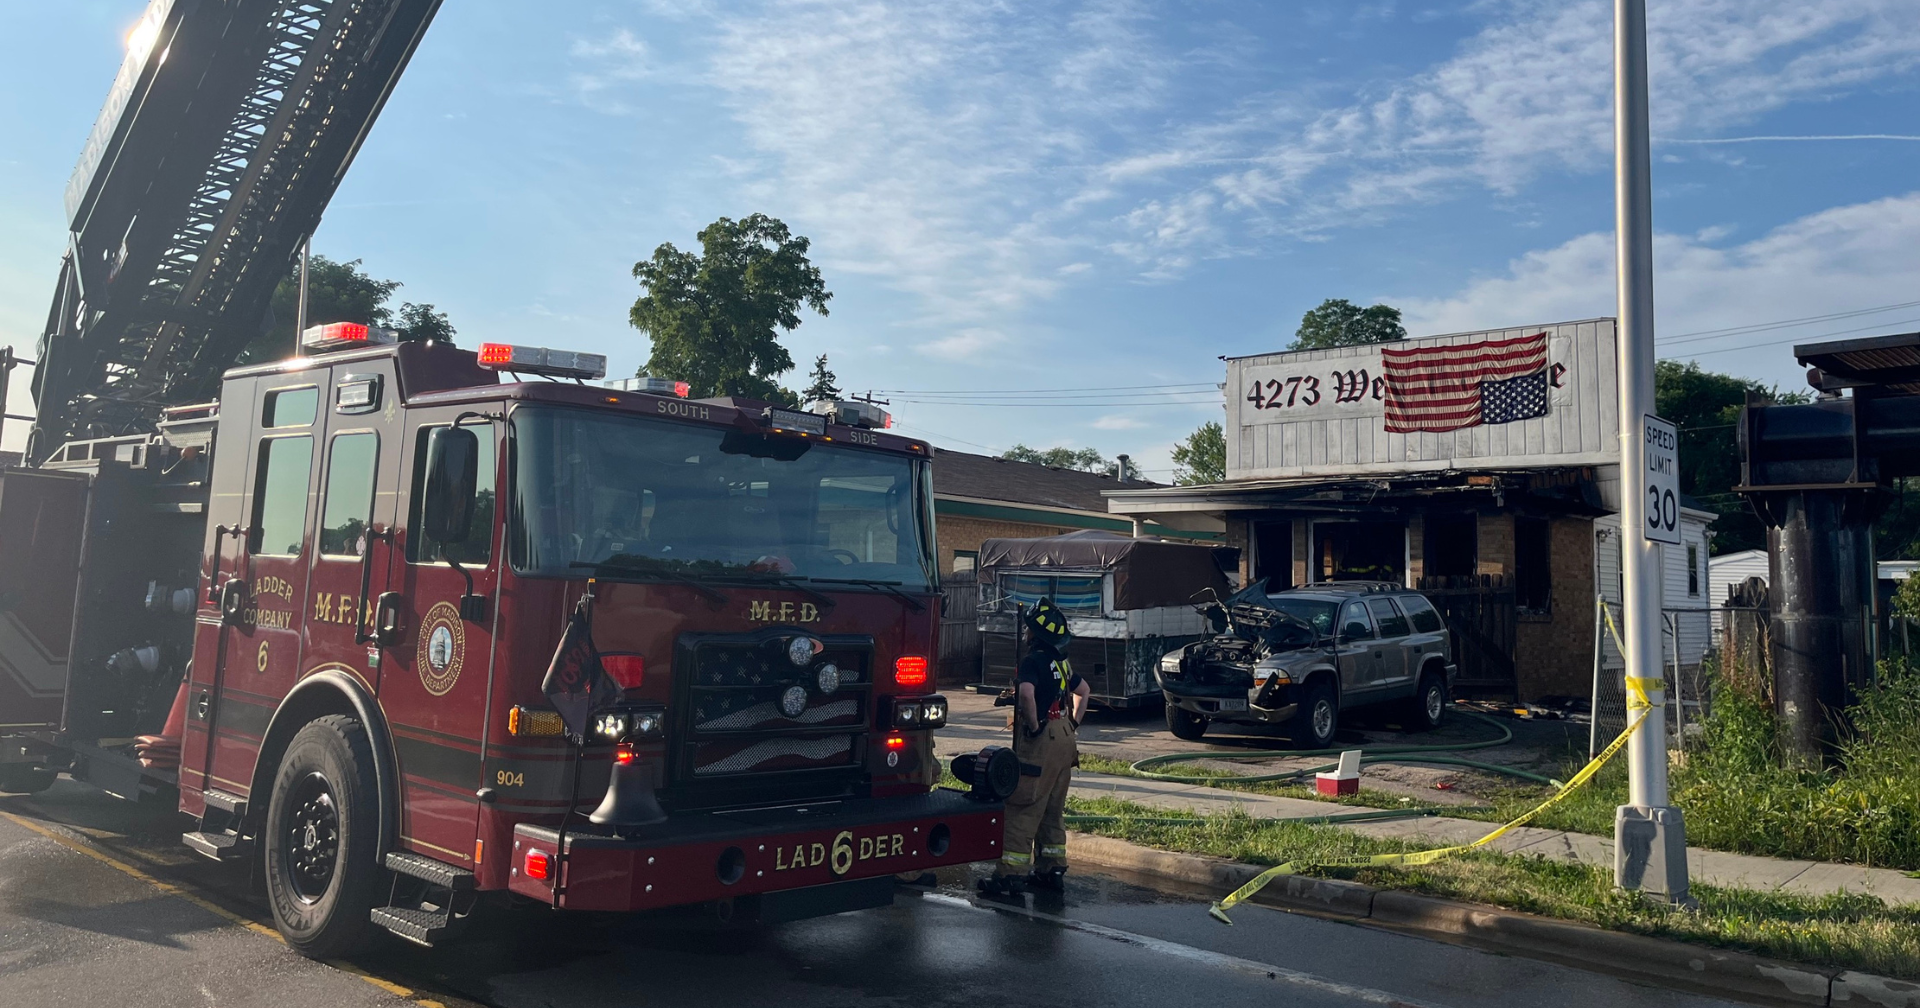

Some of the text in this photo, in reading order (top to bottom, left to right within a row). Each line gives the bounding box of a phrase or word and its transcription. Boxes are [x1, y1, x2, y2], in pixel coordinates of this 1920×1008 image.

[1247, 375, 1321, 410] 4273
[657, 401, 878, 446] SOUTH SIDE
[1647, 426, 1675, 451] SPEED
[1649, 452, 1672, 476] LIMIT
[1648, 484, 1676, 532] 30
[249, 576, 293, 603] LADDER
[243, 604, 293, 629] COMPANY
[421, 605, 463, 644] CITY OF MADISON
[750, 600, 820, 622] M.F.D.
[257, 639, 269, 672] 6
[425, 656, 461, 691] DEPARTMENT
[497, 770, 524, 787] 904
